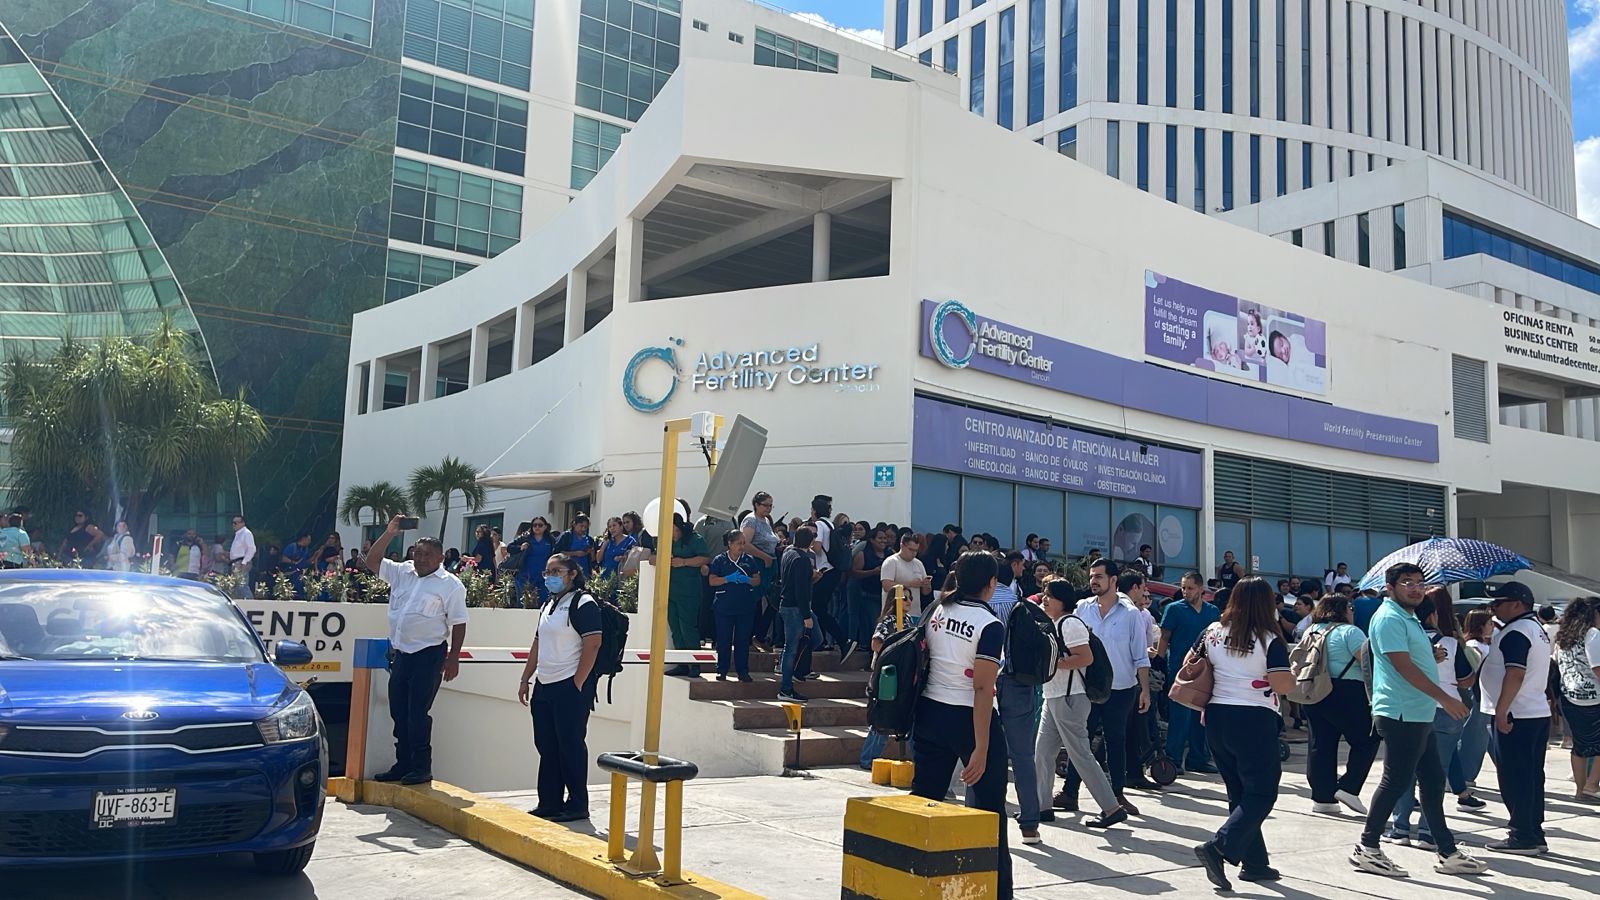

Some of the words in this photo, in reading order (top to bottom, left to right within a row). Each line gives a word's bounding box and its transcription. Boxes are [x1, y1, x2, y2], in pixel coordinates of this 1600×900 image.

[1153, 294, 1164, 306] Let
[1164, 299, 1172, 309] us
[1172, 300, 1186, 314] help
[1186, 307, 1198, 317] you
[1153, 306, 1168, 319] fulfill
[1167, 311, 1178, 322] the
[1178, 315, 1198, 328] dream
[980, 321, 1033, 350] Advanced
[1154, 319, 1161, 329] of
[1161, 321, 1190, 340] starting
[1191, 330, 1197, 339] a
[1503, 310, 1544, 330] OFICINAS
[1545, 321, 1574, 338] RENTA
[1163, 332, 1188, 351] family.
[1504, 326, 1544, 346] BUSINESS
[1545, 336, 1578, 353] CENTER
[694, 342, 818, 371] Advanced
[978, 338, 1018, 366] Fertility
[1018, 349, 1054, 373] Center
[691, 366, 780, 392] Fertility
[787, 361, 880, 386] Center
[965, 416, 1005, 439] CENTRO
[1005, 425, 1054, 447] AVANZADO
[1056, 435, 1069, 450] DE
[1072, 439, 1112, 459] ATENCIÓN
[1119, 447, 1131, 462] LA
[1131, 449, 1160, 468] MUJER
[1323, 422, 1341, 434] World
[1341, 425, 1365, 440] Fertility
[1365, 429, 1403, 445] Preservation
[1403, 436, 1423, 447] Center
[968, 440, 1017, 460] INFERTILIDAD
[1025, 450, 1049, 465] BANCO
[1050, 455, 1061, 467] DE
[1062, 456, 1089, 472] ÓVULOS
[968, 457, 1018, 476] GINECOLOGÍA
[1024, 467, 1049, 481] BANCO
[1050, 471, 1061, 483] DE
[1062, 473, 1084, 487] SEMEN
[1096, 479, 1137, 495] OBSTETRICIA
[945, 617, 975, 638] mts
[97, 795, 173, 815] UVF-863-E
